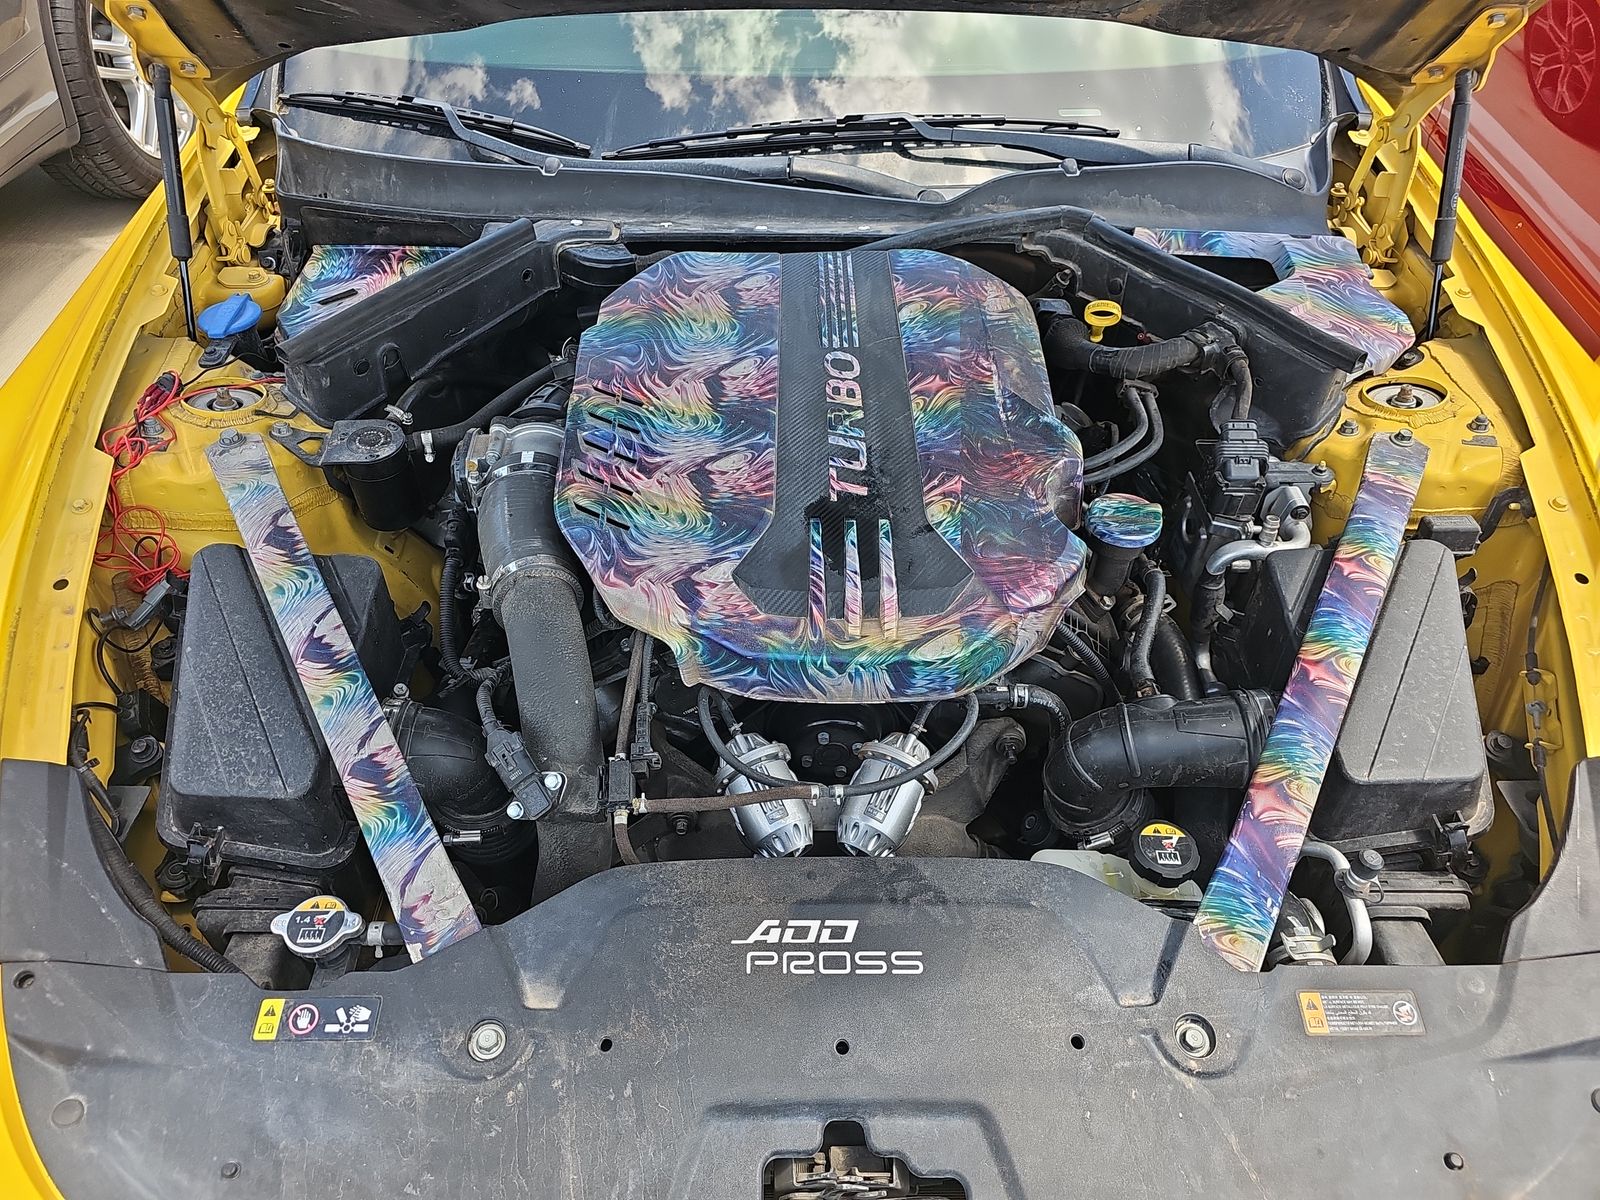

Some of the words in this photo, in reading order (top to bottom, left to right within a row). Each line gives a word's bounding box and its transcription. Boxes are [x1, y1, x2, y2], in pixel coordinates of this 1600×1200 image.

[824, 351, 868, 501] TURBO
[295, 915, 311, 924] 1.4
[746, 951, 923, 974] PROSS
